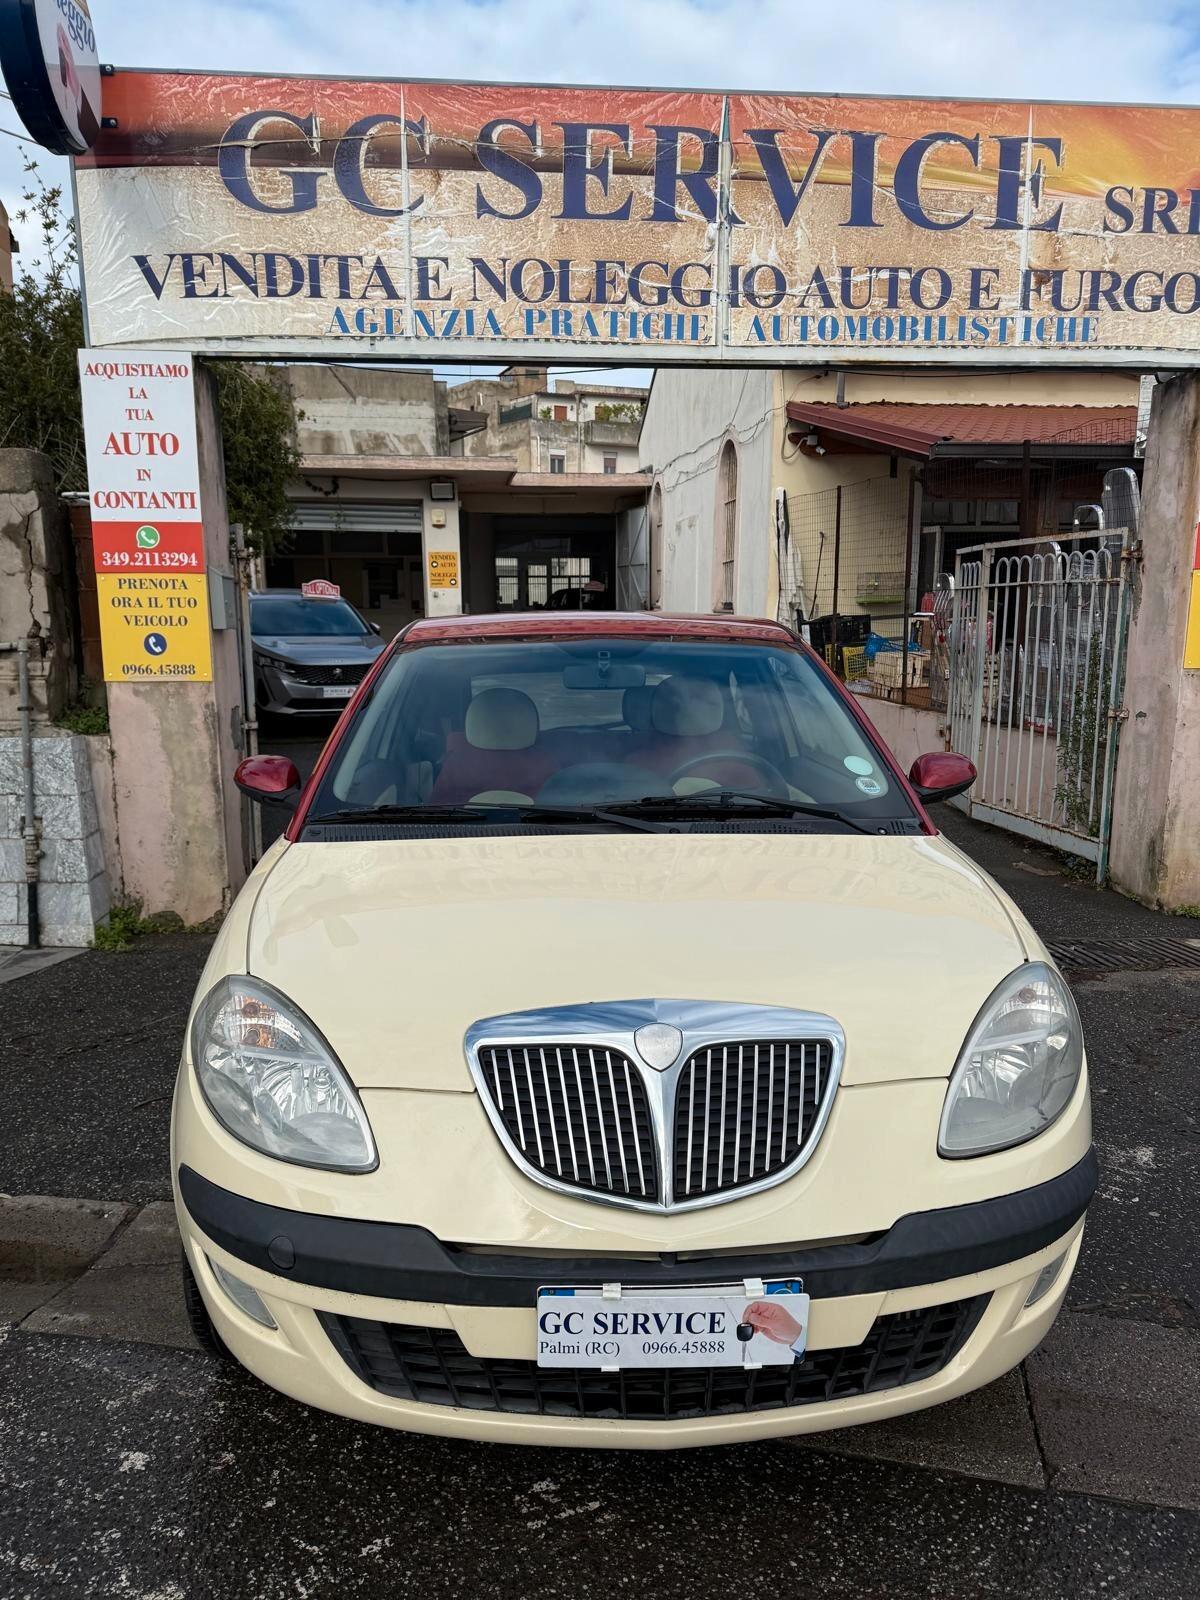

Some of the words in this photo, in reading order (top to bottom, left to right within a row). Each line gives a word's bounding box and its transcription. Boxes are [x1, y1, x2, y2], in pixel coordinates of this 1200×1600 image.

[217, 109, 427, 217] GC
[476, 118, 1063, 232] SERVICE
[130, 252, 407, 301] VENDITA
[411, 256, 452, 301] E
[467, 257, 787, 309] NOLEGGIO
[800, 264, 953, 311] AUTO
[966, 268, 1002, 311] E
[325, 306, 501, 337] AGENZIA
[523, 309, 711, 342] PRATICHE
[746, 314, 1099, 344] AUTOMOBILISTICHE
[84, 362, 189, 379] ACQUISTIAMO
[128, 386, 148, 399] LA
[125, 409, 153, 421] TUA
[102, 432, 180, 456] AUTO
[136, 469, 151, 481] IN
[93, 490, 197, 510] CONTANTI
[102, 552, 198, 567] 349.2113294
[117, 578, 188, 590] PRENOTA
[111, 597, 143, 609] ORA
[148, 597, 163, 608] IL
[166, 597, 198, 608] TUO
[123, 615, 188, 627] VEICOLO
[121, 663, 196, 676] 0966.45888
[539, 1311, 584, 1335] GC
[593, 1311, 726, 1335] SERVICE
[539, 1341, 580, 1355] Palmi
[585, 1341, 620, 1357] (RC)
[642, 1341, 725, 1355] 0966.45888
